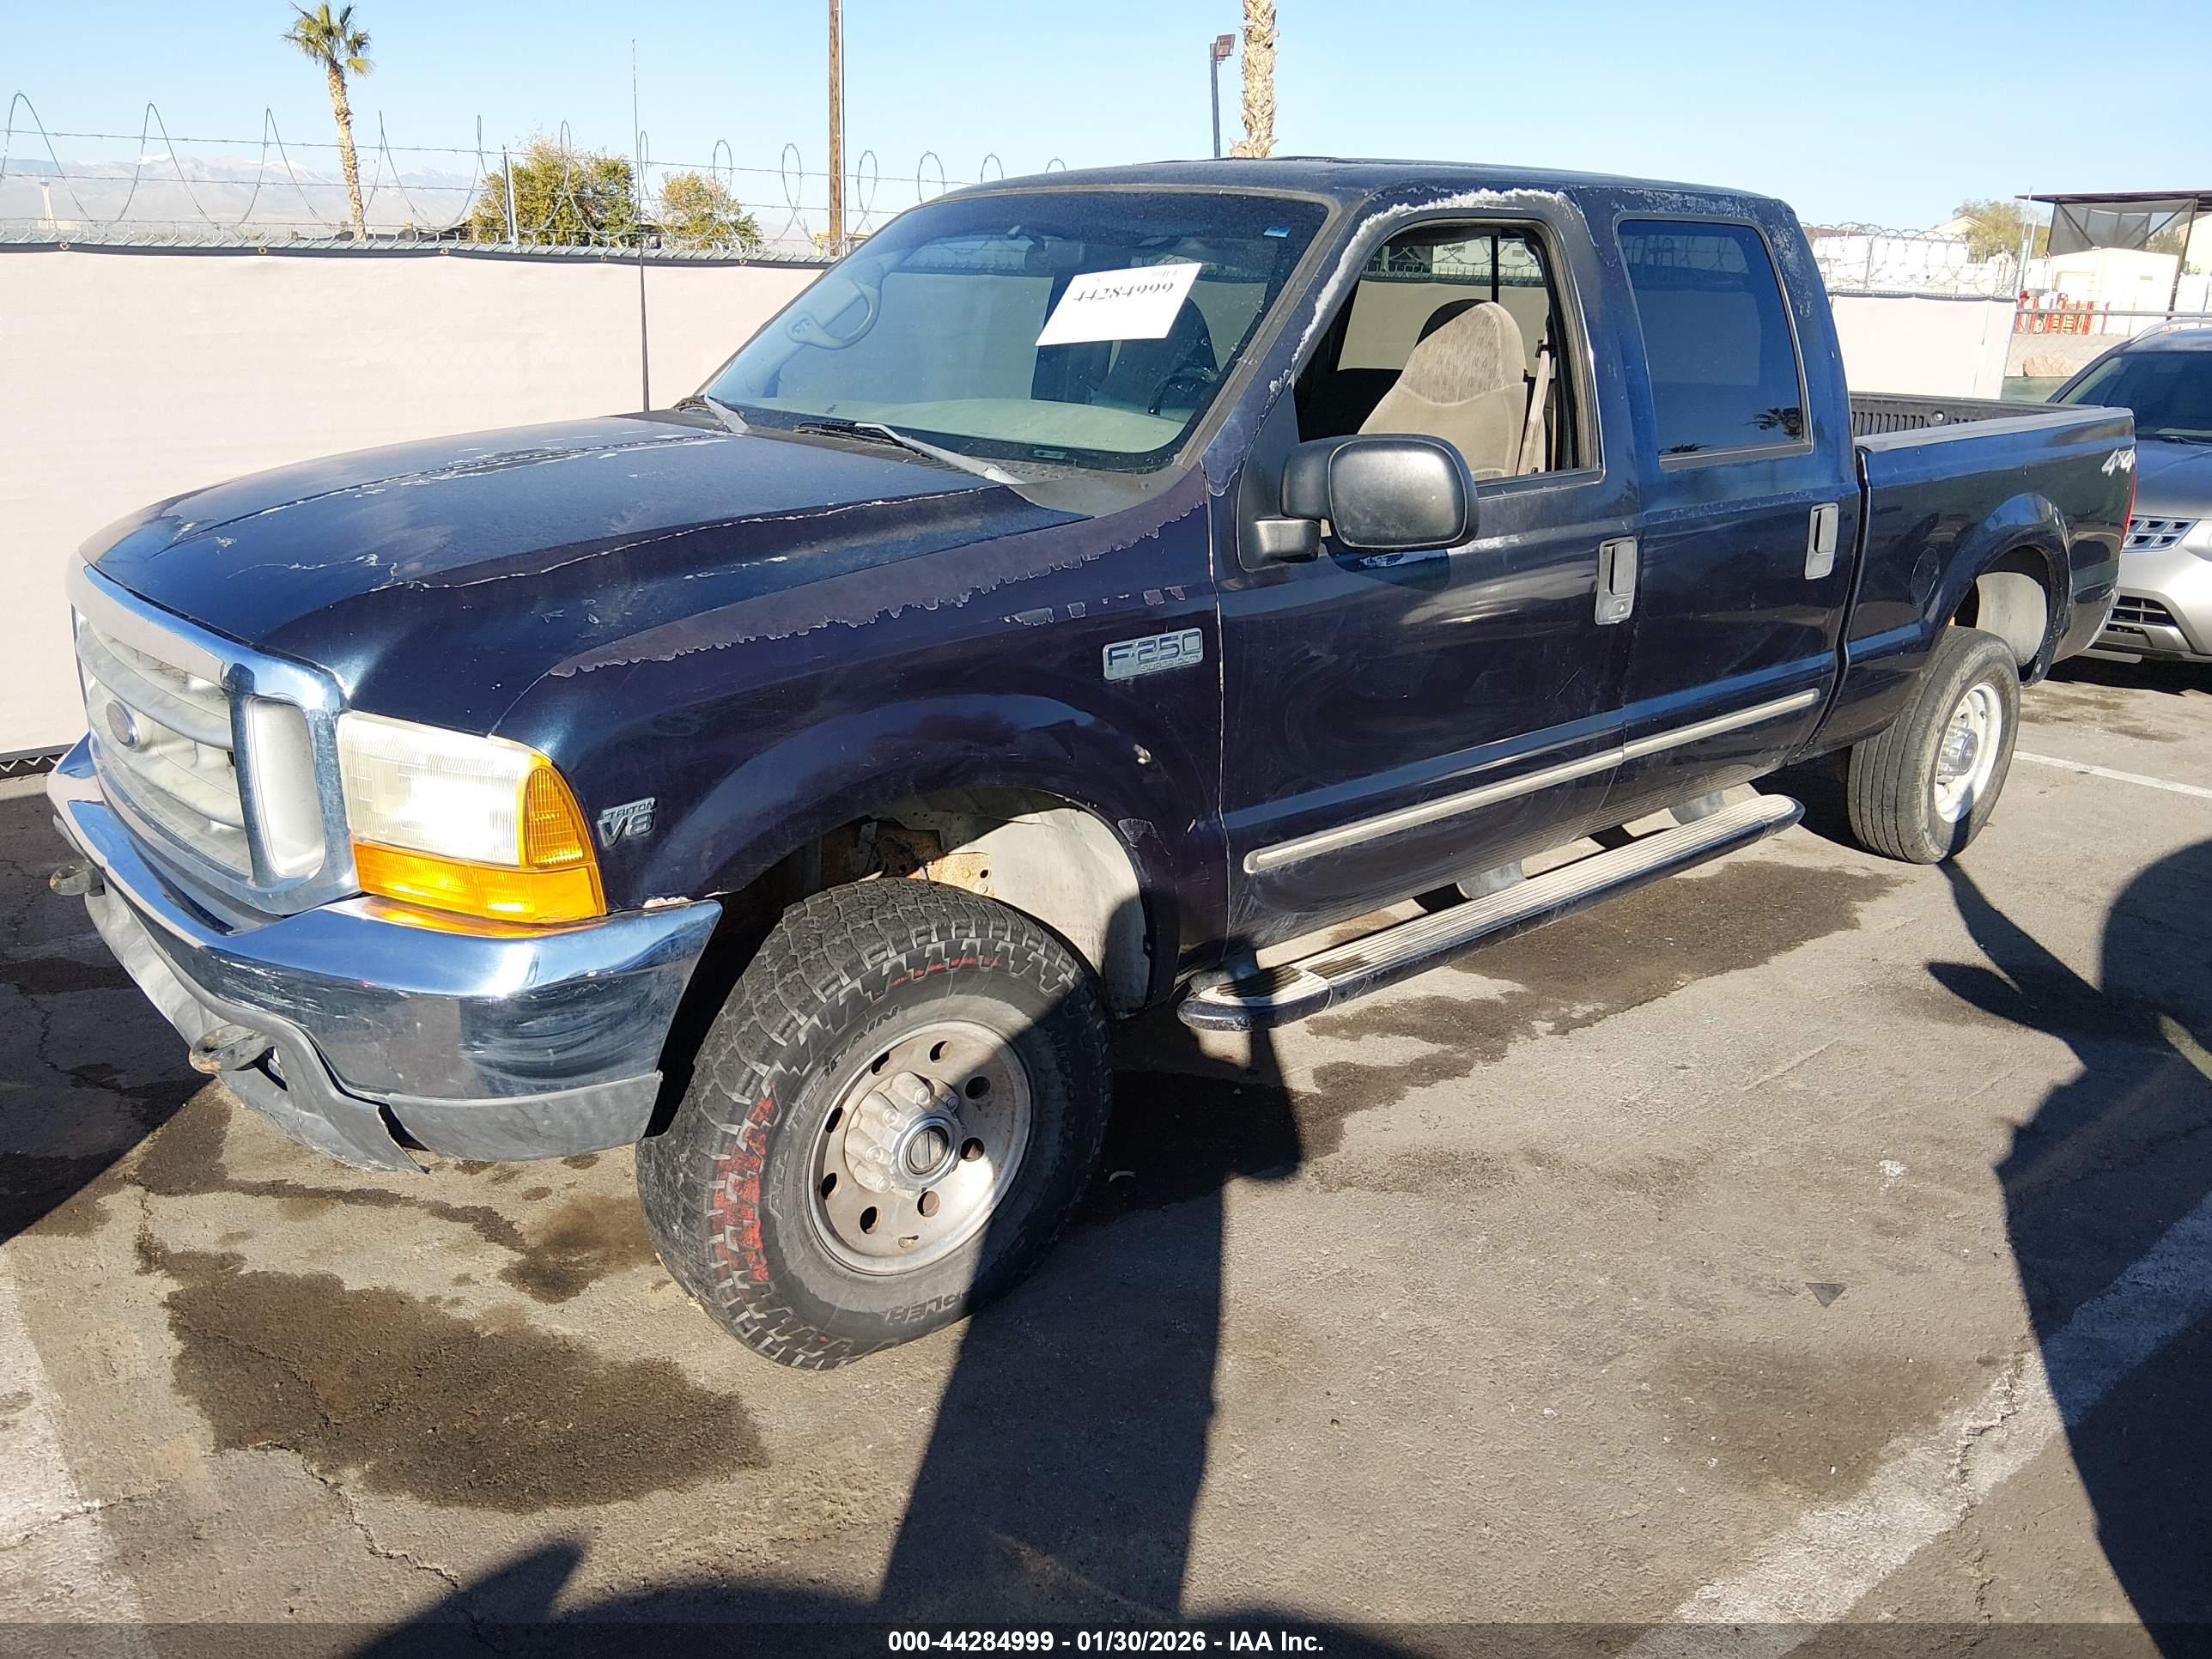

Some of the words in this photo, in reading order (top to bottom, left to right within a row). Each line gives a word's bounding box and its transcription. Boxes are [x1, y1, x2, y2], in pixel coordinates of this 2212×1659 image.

[1073, 282, 1174, 301] 44284999
[1140, 659, 1175, 672] SUPER
[604, 799, 655, 819] TRITON
